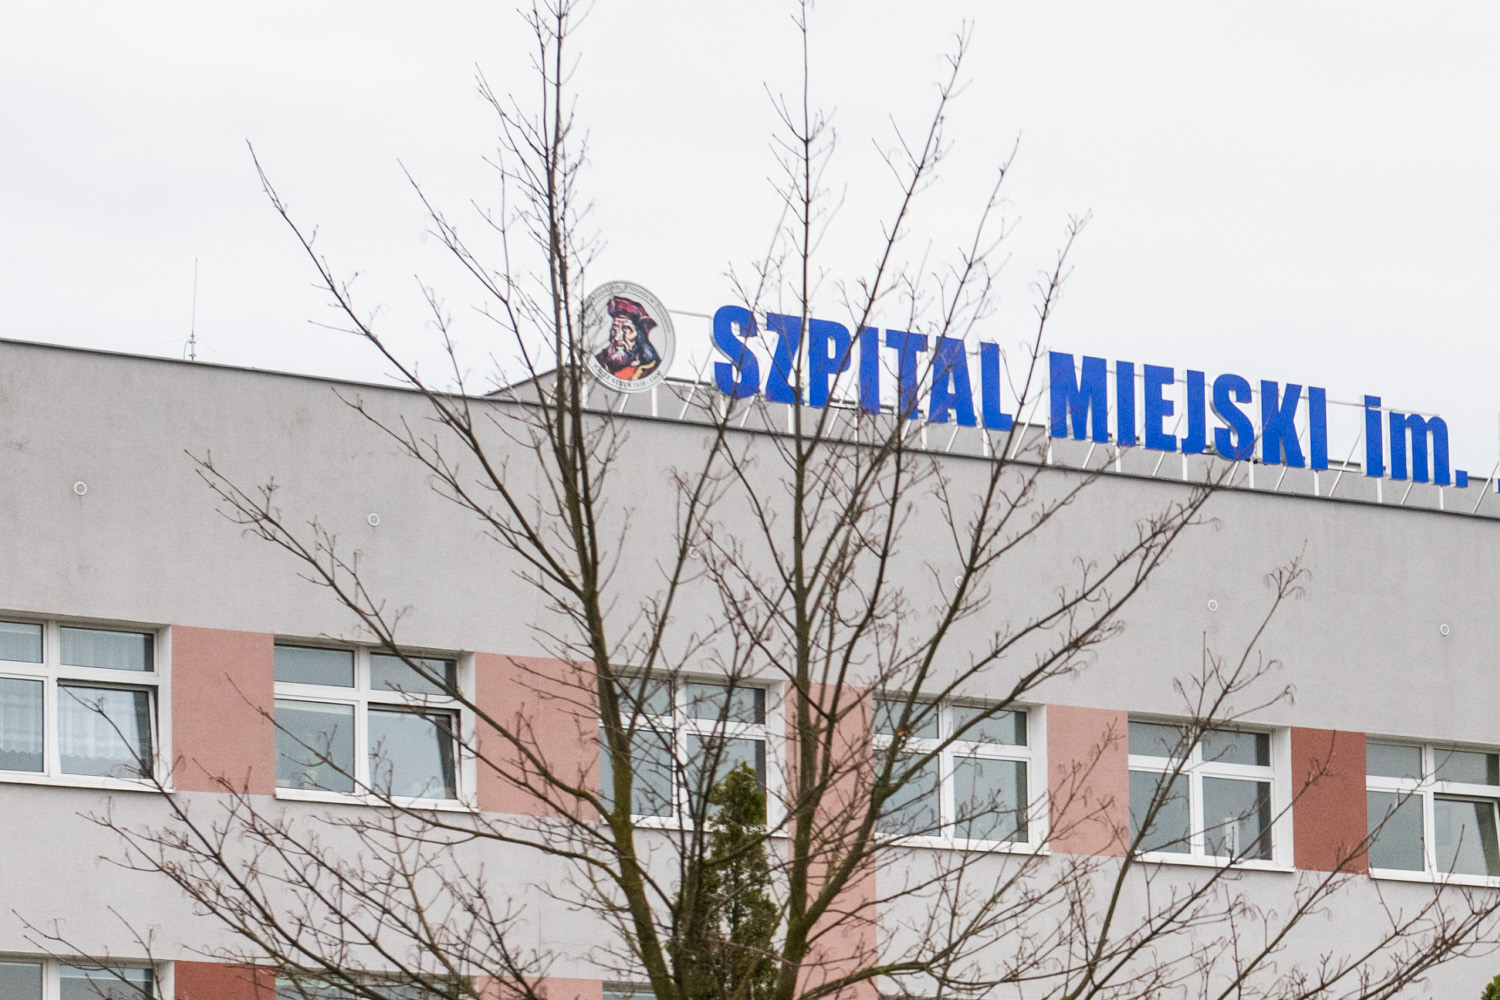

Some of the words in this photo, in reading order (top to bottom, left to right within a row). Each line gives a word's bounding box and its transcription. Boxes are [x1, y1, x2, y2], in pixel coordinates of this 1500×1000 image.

[711, 304, 1014, 431] SZPITAL
[1048, 351, 1329, 470] MIEJSKI
[1361, 394, 1468, 488] im.
